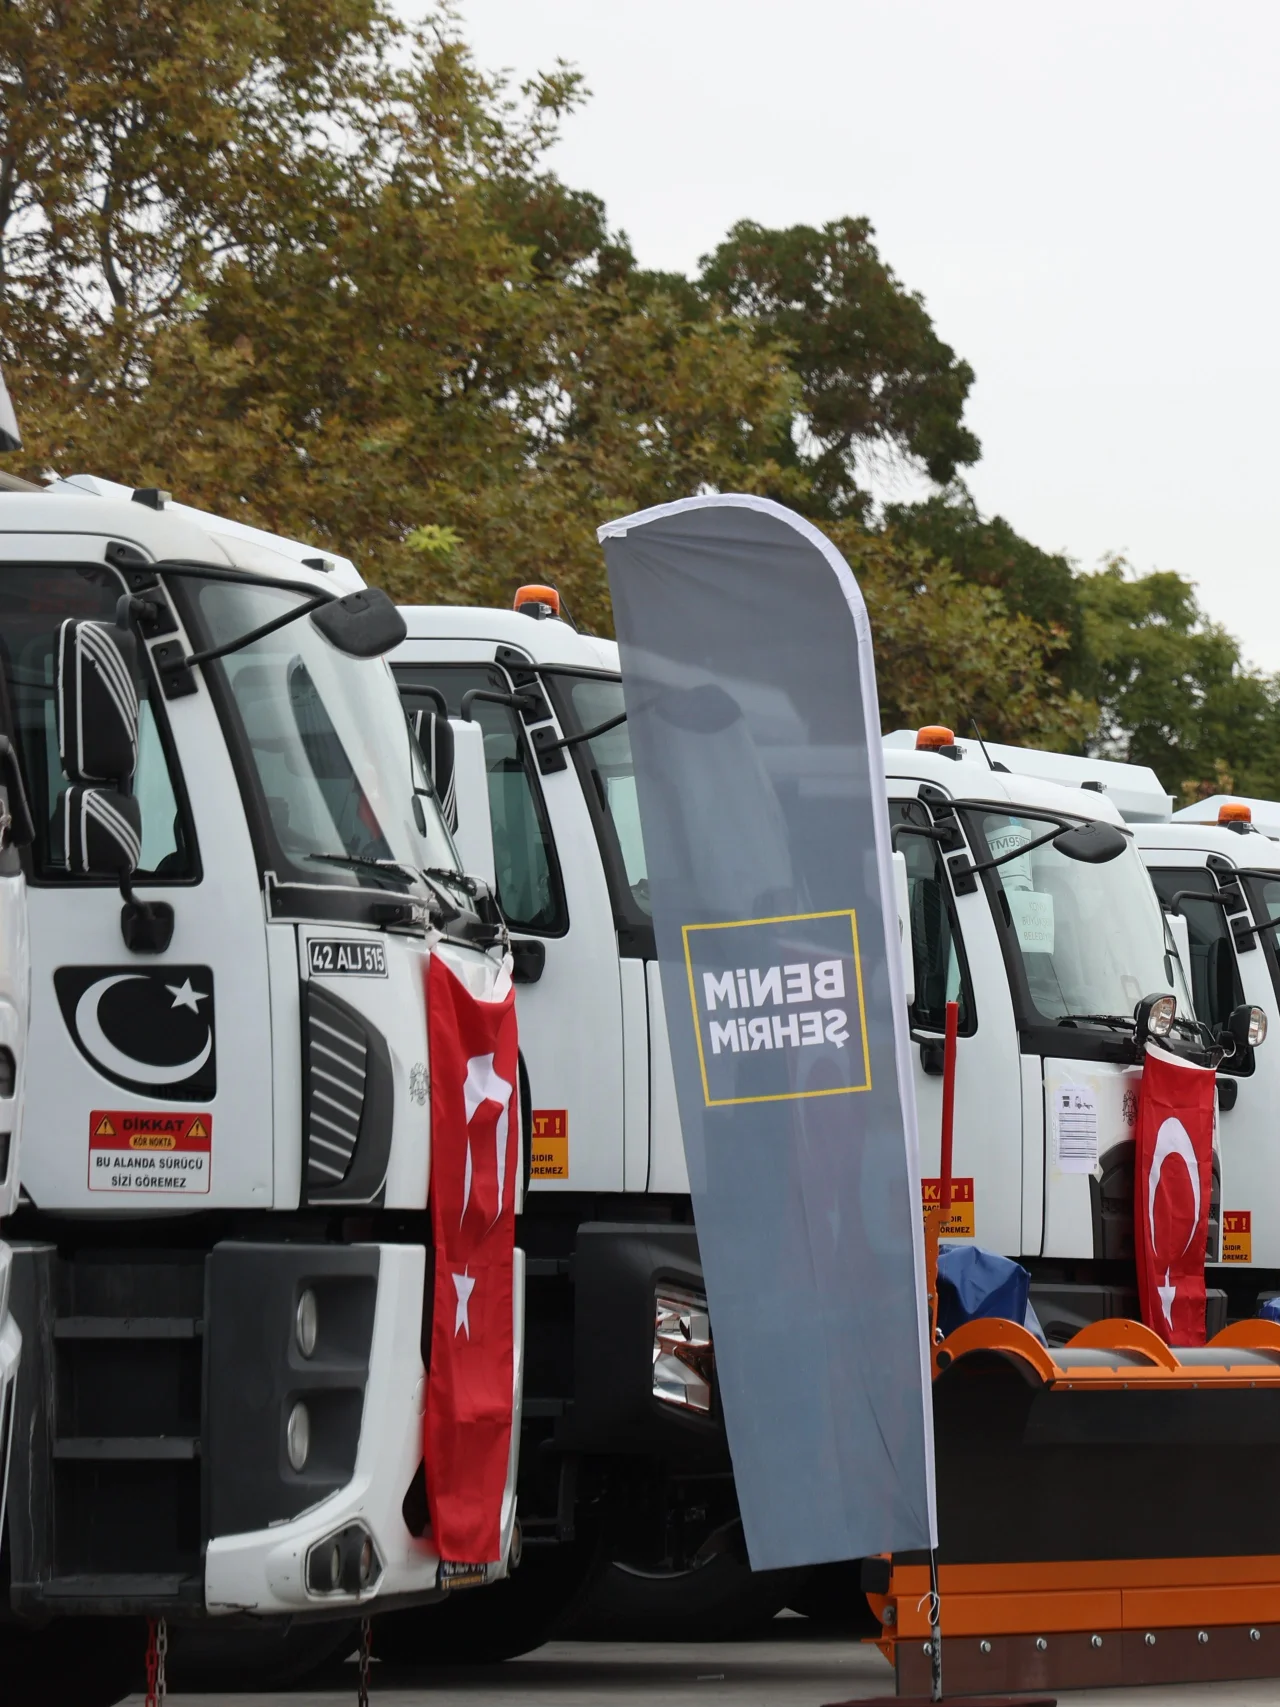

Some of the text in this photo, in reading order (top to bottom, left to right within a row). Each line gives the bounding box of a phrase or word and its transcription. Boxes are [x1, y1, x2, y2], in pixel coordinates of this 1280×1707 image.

[312, 945, 385, 971] 42 ALJ 515
[123, 1117, 184, 1131] DİKKAT
[133, 1136, 172, 1147] KÖR NOKTA
[96, 1157, 203, 1170] BU ALANDA SÜRÜCÜ
[532, 1154, 554, 1162] SIDIR
[531, 1167, 563, 1175] REMEZ
[111, 1174, 187, 1188] SİZİ GÖREMEZ
[940, 1225, 970, 1234] ÖREMEZ
